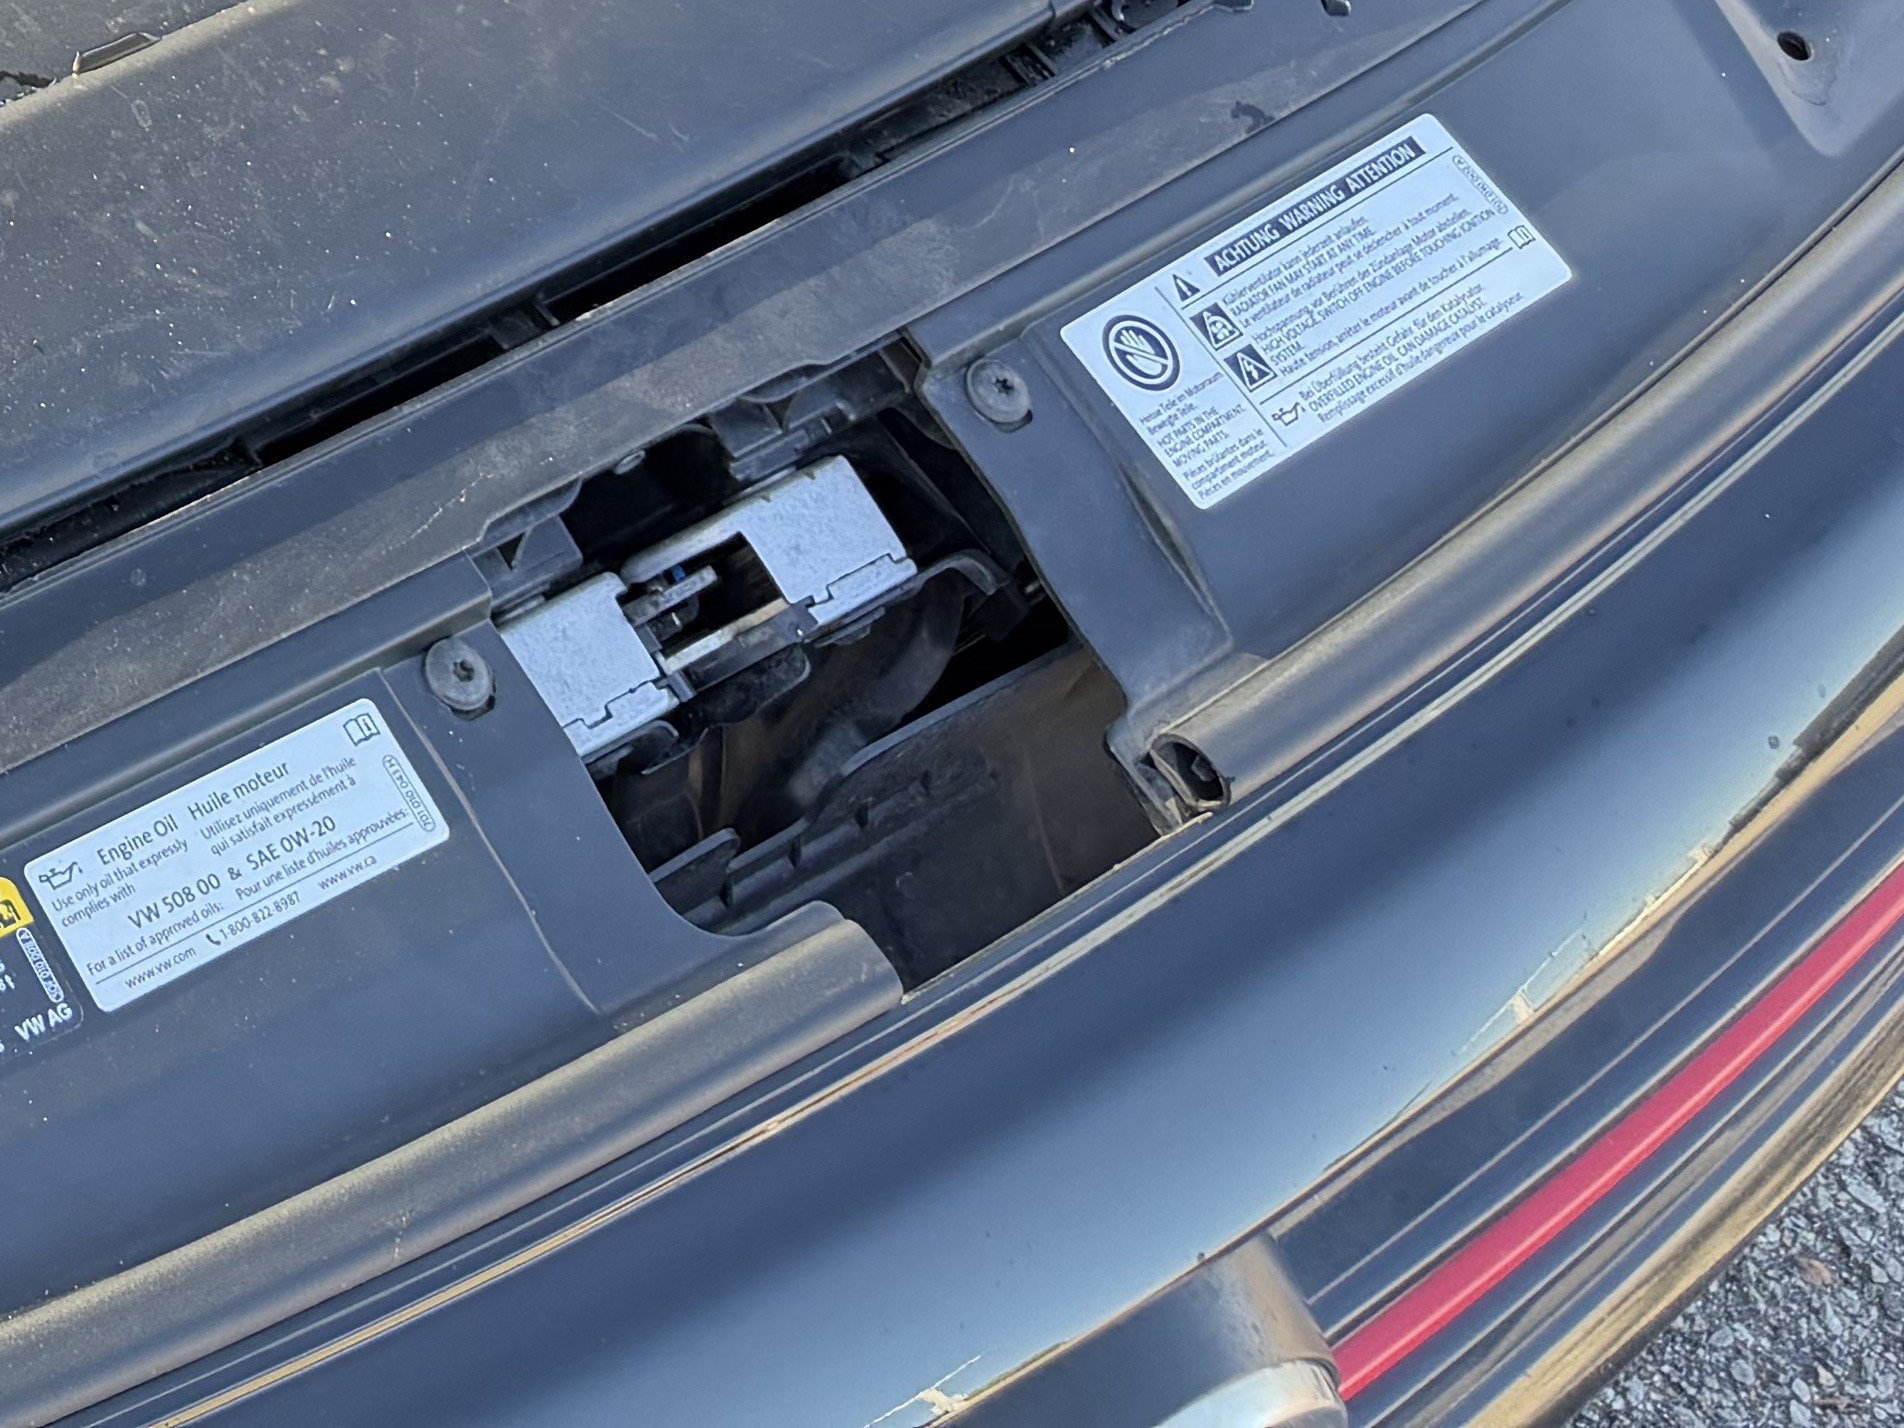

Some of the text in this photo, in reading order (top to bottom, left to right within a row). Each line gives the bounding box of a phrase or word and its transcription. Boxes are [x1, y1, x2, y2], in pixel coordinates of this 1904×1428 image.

[1209, 222, 1281, 271] ACHTUNG
[1277, 183, 1347, 232] WARNING
[1342, 142, 1417, 193] ATTENTION
[1229, 237, 1356, 317] RADIATOR FAN MAY START AT ANY
[1238, 315, 1253, 328] Le
[1248, 290, 1294, 322] ventilateur
[1289, 285, 1303, 297] de
[1298, 264, 1338, 292] radiateur
[1333, 254, 1357, 273] peut
[1406, 211, 1427, 227] tout
[1259, 206, 1496, 355] HIGH SWITCH OFF ENGINE BEFORE TOUCHING IGNITION
[1355, 266, 1372, 280] der
[1410, 226, 1438, 247] Motor
[1277, 355, 1306, 377] Haute
[1358, 315, 1372, 327] le
[1366, 298, 1399, 322] moteur
[1394, 285, 1420, 305] avant
[1416, 278, 1431, 292] de
[1426, 261, 1459, 285] toucher
[1297, 385, 1316, 401] Bei
[1355, 339, 1388, 365] besteht
[1383, 323, 1415, 347] Gefahr
[1410, 314, 1429, 330] für
[1423, 305, 1443, 322] den
[1362, 368, 1398, 395] excessif
[1417, 328, 1463, 362] dangereux
[1456, 317, 1480, 338] pour
[1473, 312, 1487, 324] le
[1307, 377, 1357, 413] OVERFILLED
[1351, 359, 1385, 385] ENGINE
[1395, 339, 1417, 357] CAN
[1412, 318, 1451, 346] DAMAGE
[1155, 405, 1219, 448] HOT PARTS IN THE
[1163, 435, 1194, 458] ENGINE
[1171, 442, 1206, 468] MOVING
[185, 758, 291, 821] Huile moteur
[198, 753, 357, 840] Utilisez uniquement de l'huile
[207, 773, 357, 858] qui satisfait expressément à
[50, 835, 191, 913] Use only oil that expressly
[95, 813, 179, 870] Engine Oil
[126, 813, 338, 930] VW 508 00 & SAE 0W-20
[234, 804, 412, 901] Pour une liste d'huiles approuvées:
[58, 881, 137, 930] complies with
[85, 898, 224, 976] For a list of approved oils:
[123, 853, 378, 989] www.vw.com 1-800-822-8987 www.vw.ca
[13, 1000, 75, 1042] VW AG
